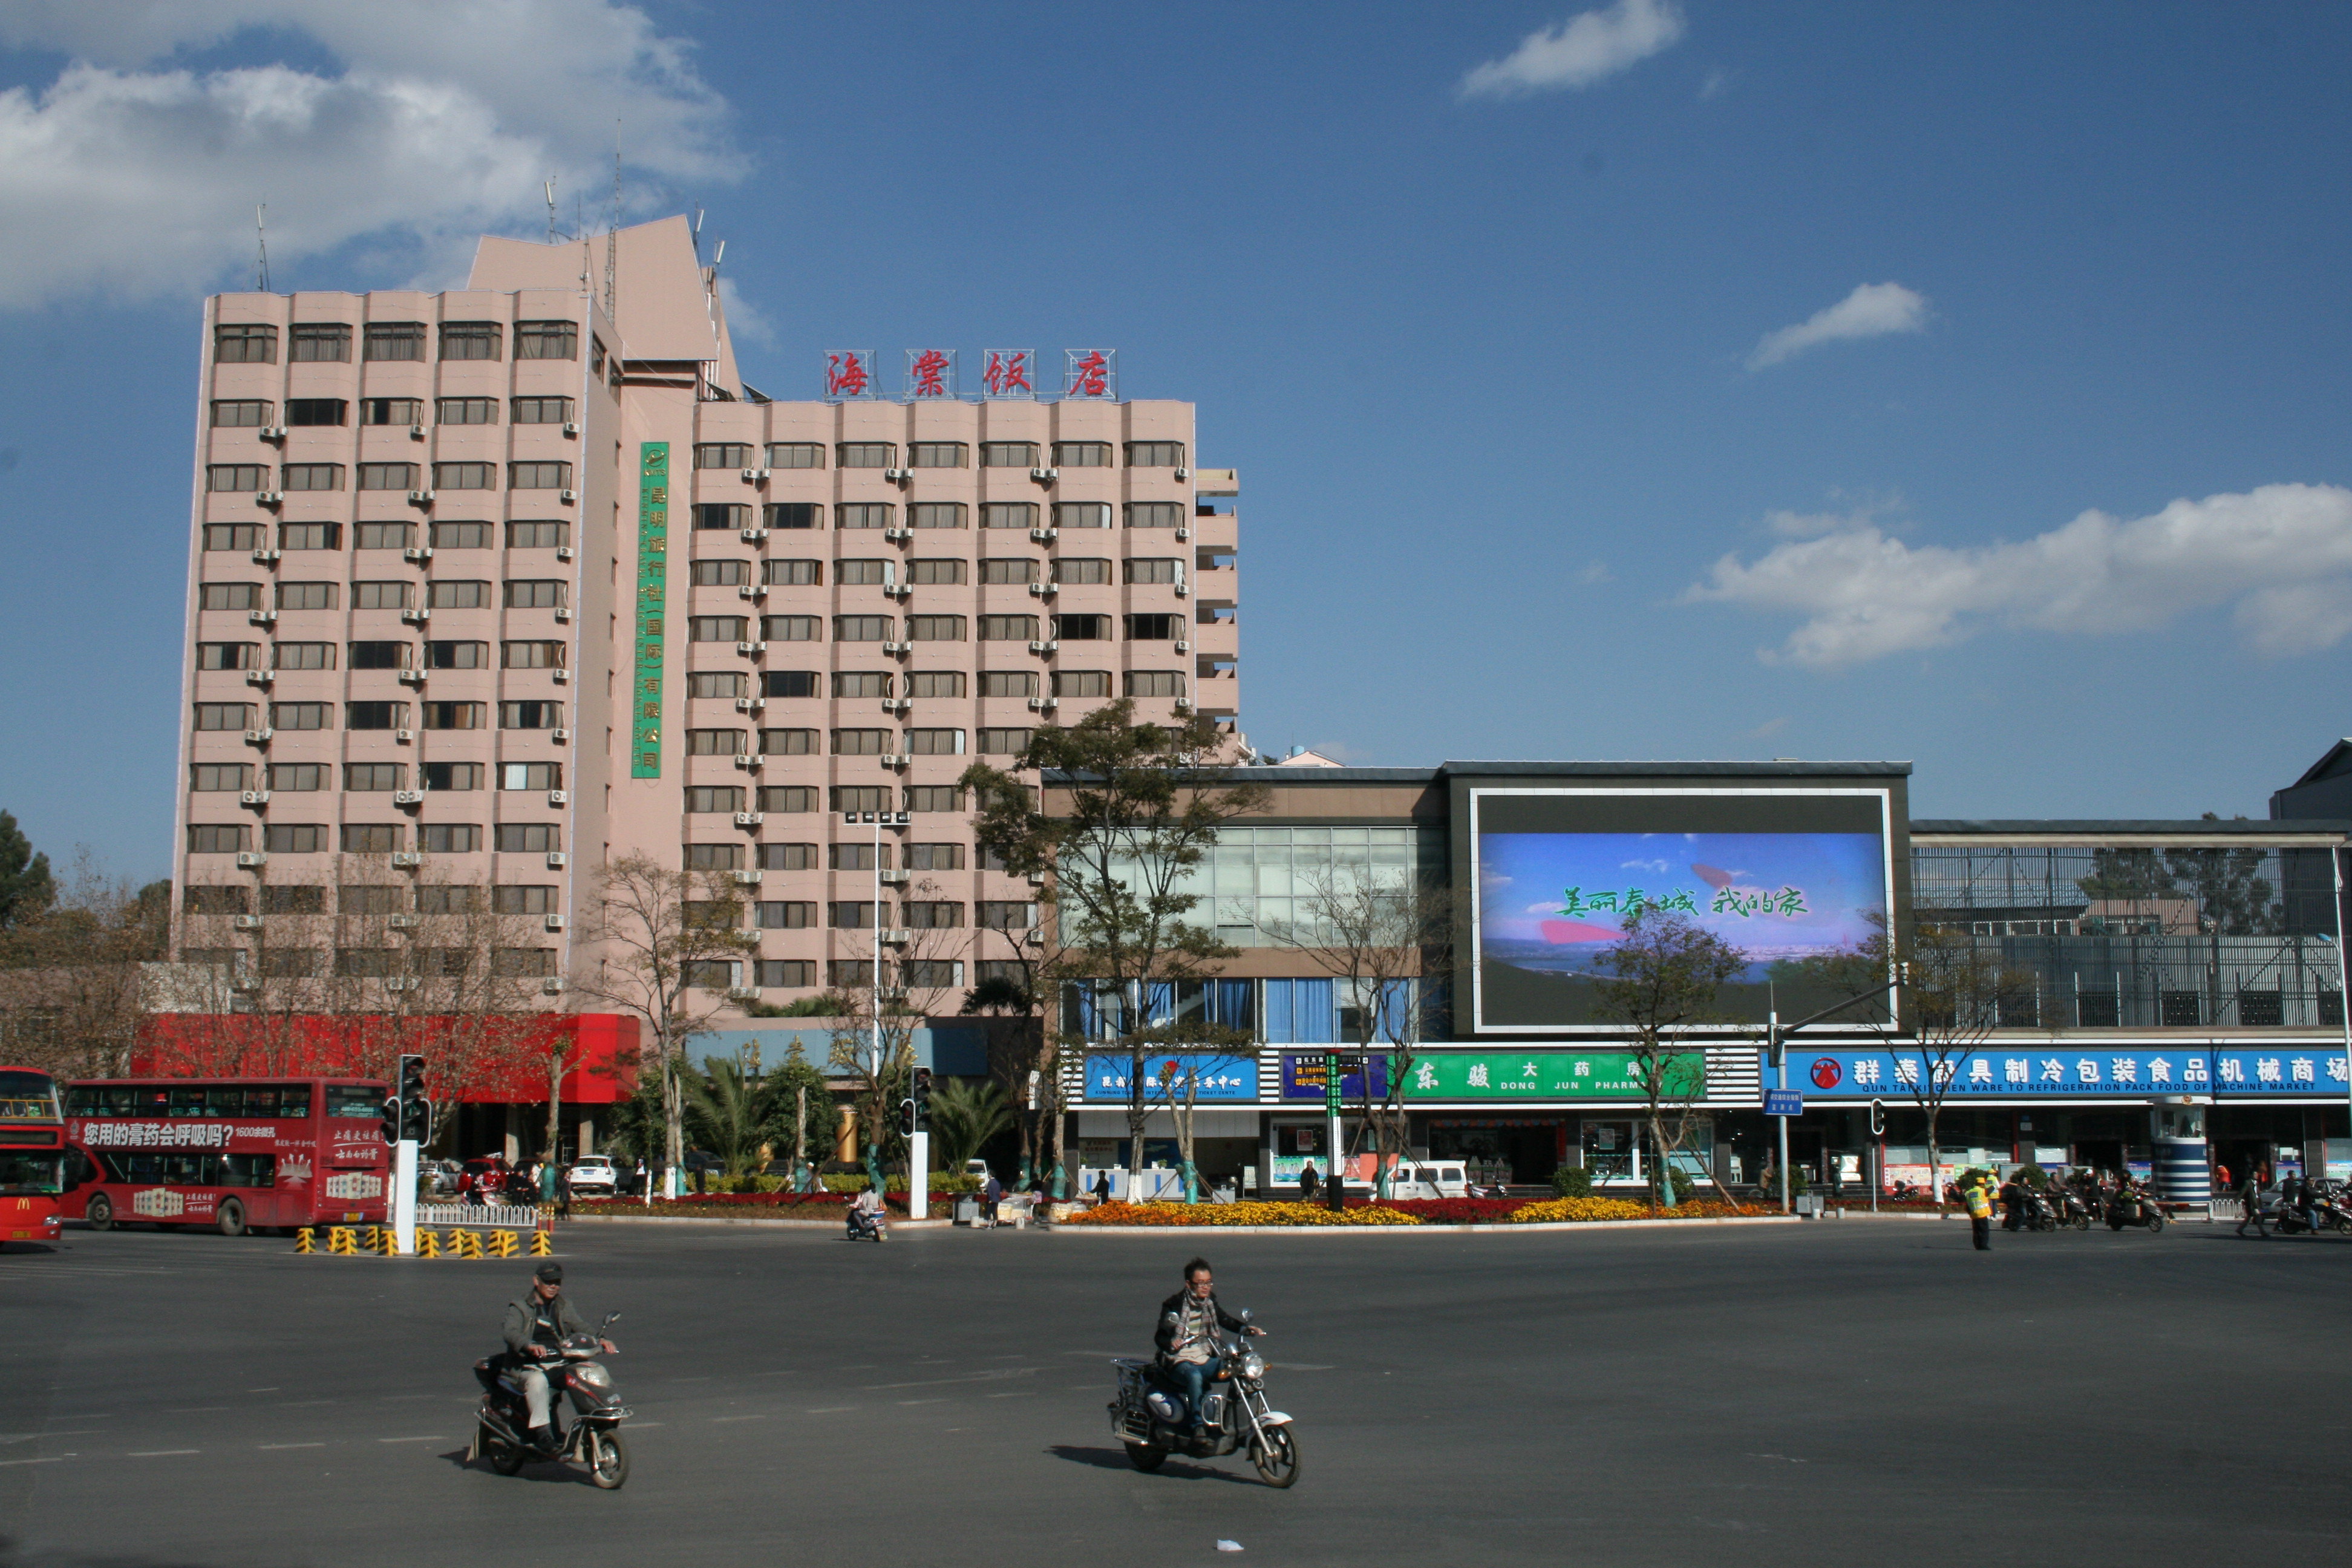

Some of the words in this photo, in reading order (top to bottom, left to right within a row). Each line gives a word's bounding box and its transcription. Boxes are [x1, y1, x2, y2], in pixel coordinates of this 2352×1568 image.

[828, 350, 1108, 396] 海棠饭店
[1555, 885, 1700, 918] 美丽春城
[1710, 886, 1809, 918] 我的家
[1414, 1062, 1641, 1089] 东骏大药房
[1854, 1057, 2348, 1084] 群泰厨具制冷包装食品机械商场
[83, 1123, 234, 1147] 您用的膏药会呼吸吗?
